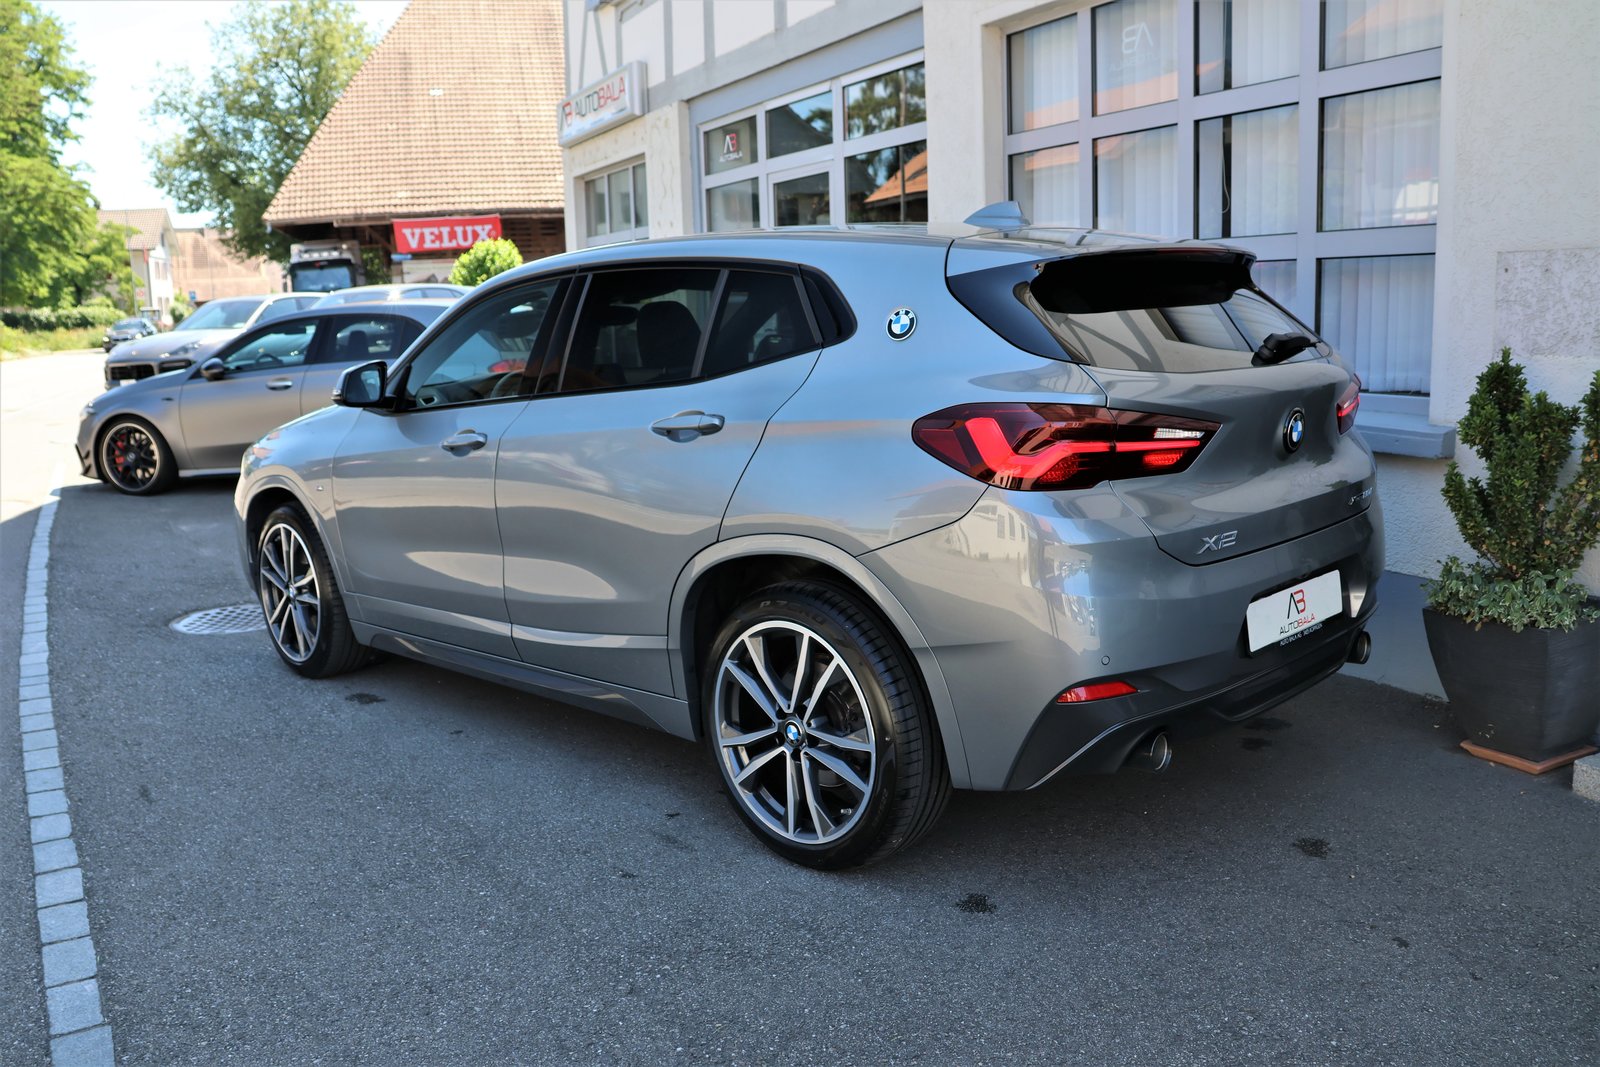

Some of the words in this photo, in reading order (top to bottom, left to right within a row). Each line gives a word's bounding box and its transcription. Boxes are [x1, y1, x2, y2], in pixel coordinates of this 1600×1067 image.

[575, 75, 626, 118] AUTOBALA
[402, 224, 492, 248] VELUX
[1195, 530, 1238, 554] X2
[1279, 612, 1316, 636] AUTOBALA
